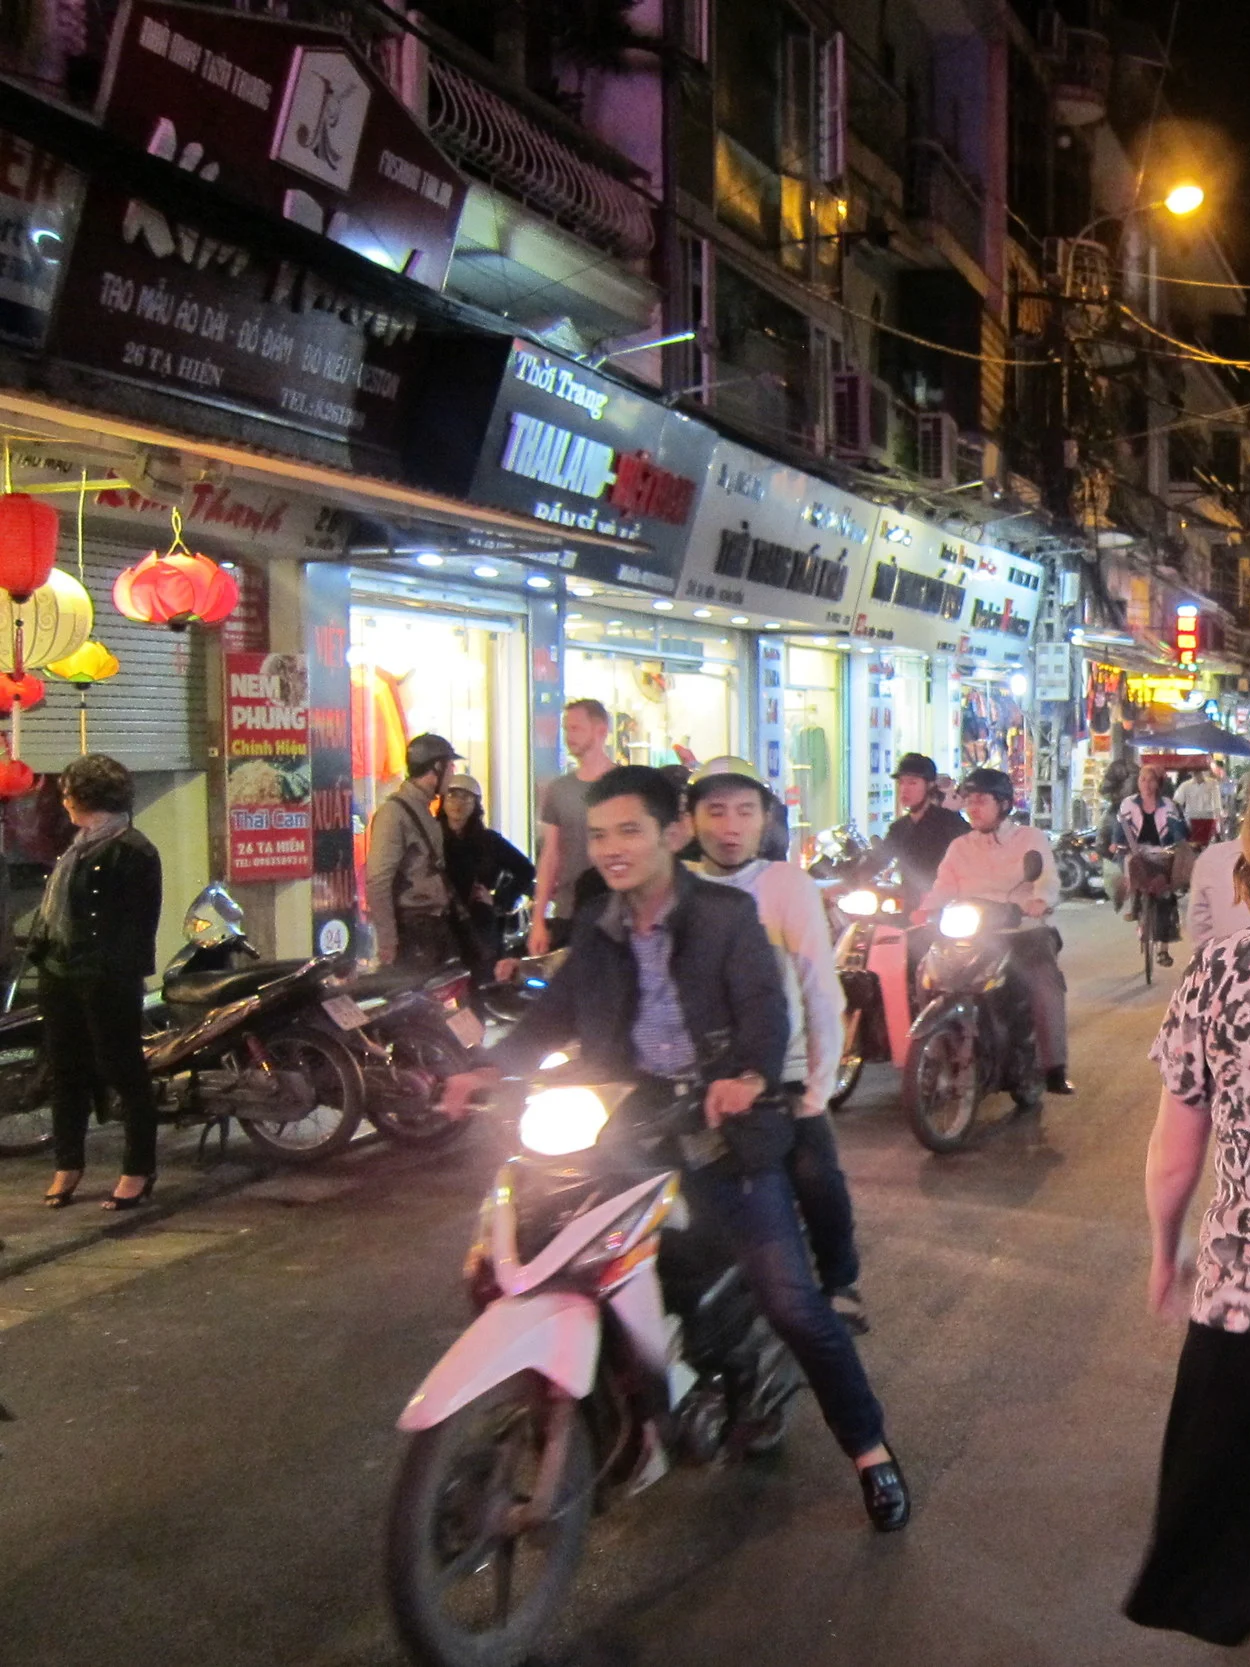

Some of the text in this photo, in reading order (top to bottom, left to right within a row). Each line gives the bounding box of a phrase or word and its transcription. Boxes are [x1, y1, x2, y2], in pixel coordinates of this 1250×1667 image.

[513, 350, 609, 421] Thời Trang
[230, 673, 281, 699] NEM
[326, 929, 342, 950] 24
